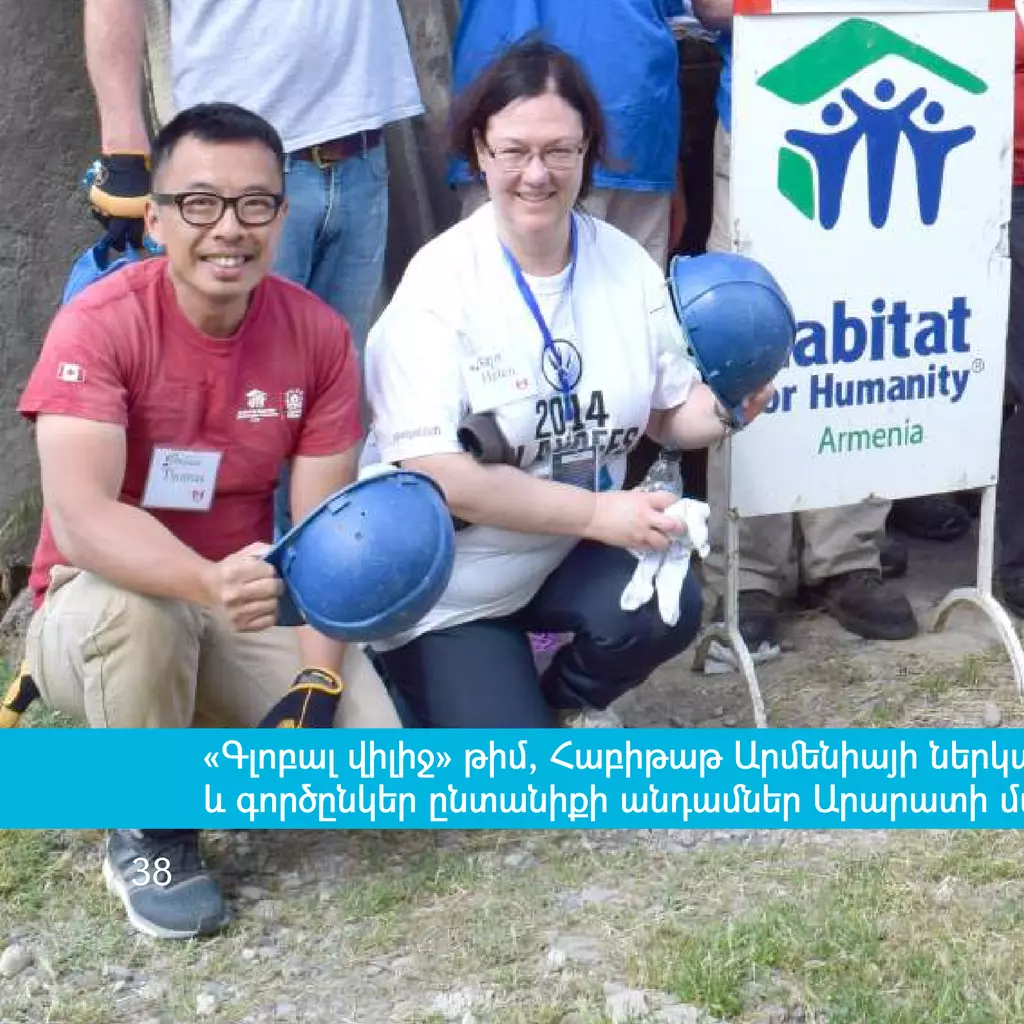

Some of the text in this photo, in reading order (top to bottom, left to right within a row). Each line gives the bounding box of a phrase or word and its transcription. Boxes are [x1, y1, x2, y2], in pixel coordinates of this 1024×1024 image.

[793, 297, 971, 367] abitat
[763, 364, 970, 414] or Humanity
[535, 389, 610, 441] 2014
[818, 419, 924, 454] Armenia
